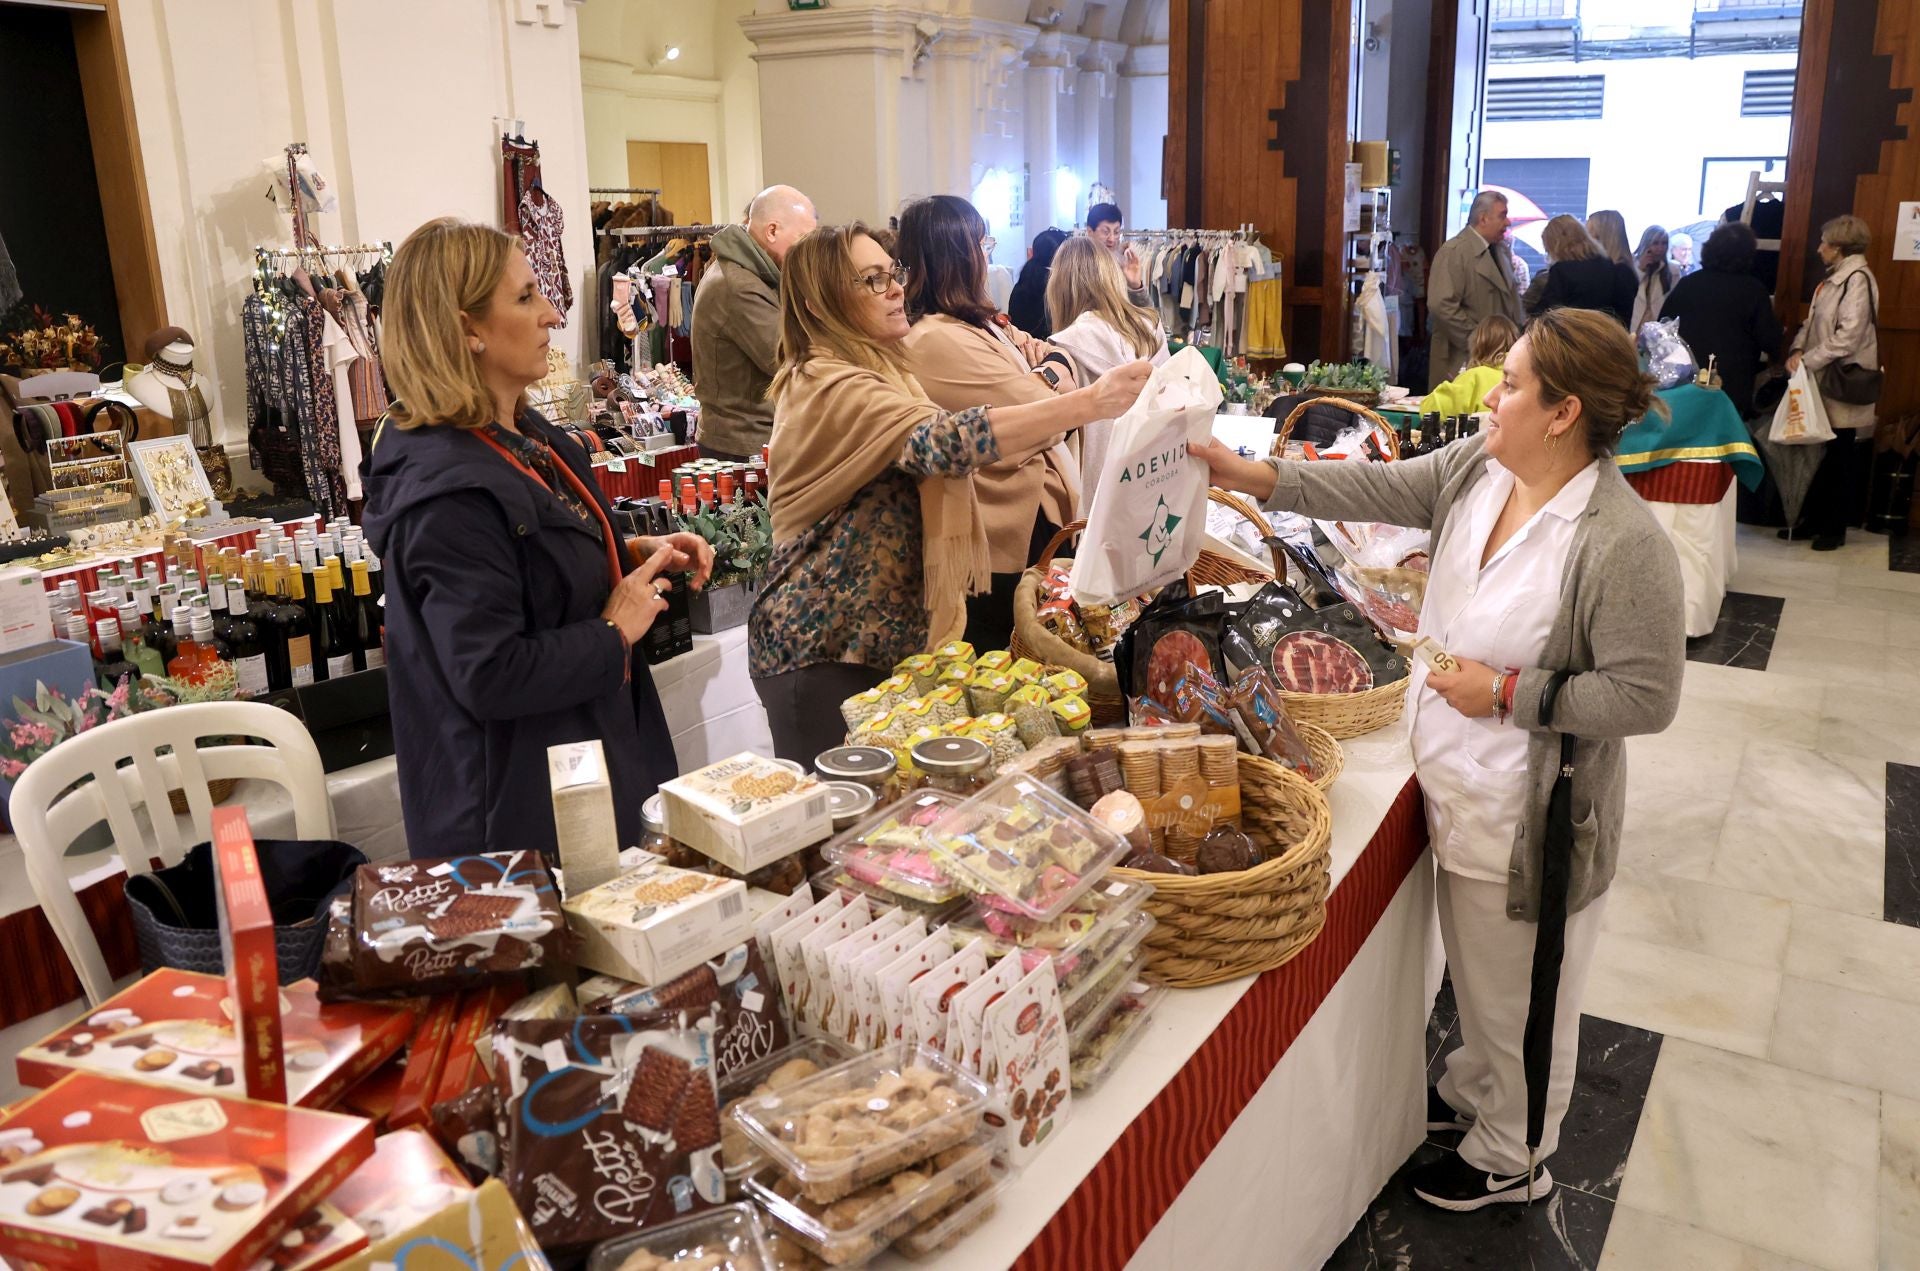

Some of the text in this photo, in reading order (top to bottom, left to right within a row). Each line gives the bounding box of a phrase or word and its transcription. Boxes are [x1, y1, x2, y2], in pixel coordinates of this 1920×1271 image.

[1434, 652, 1454, 671] 50
[370, 879, 453, 912] Petit
[404, 948, 464, 977] Petit
[716, 1012, 774, 1077] Petit
[582, 1129, 651, 1223] Petit
